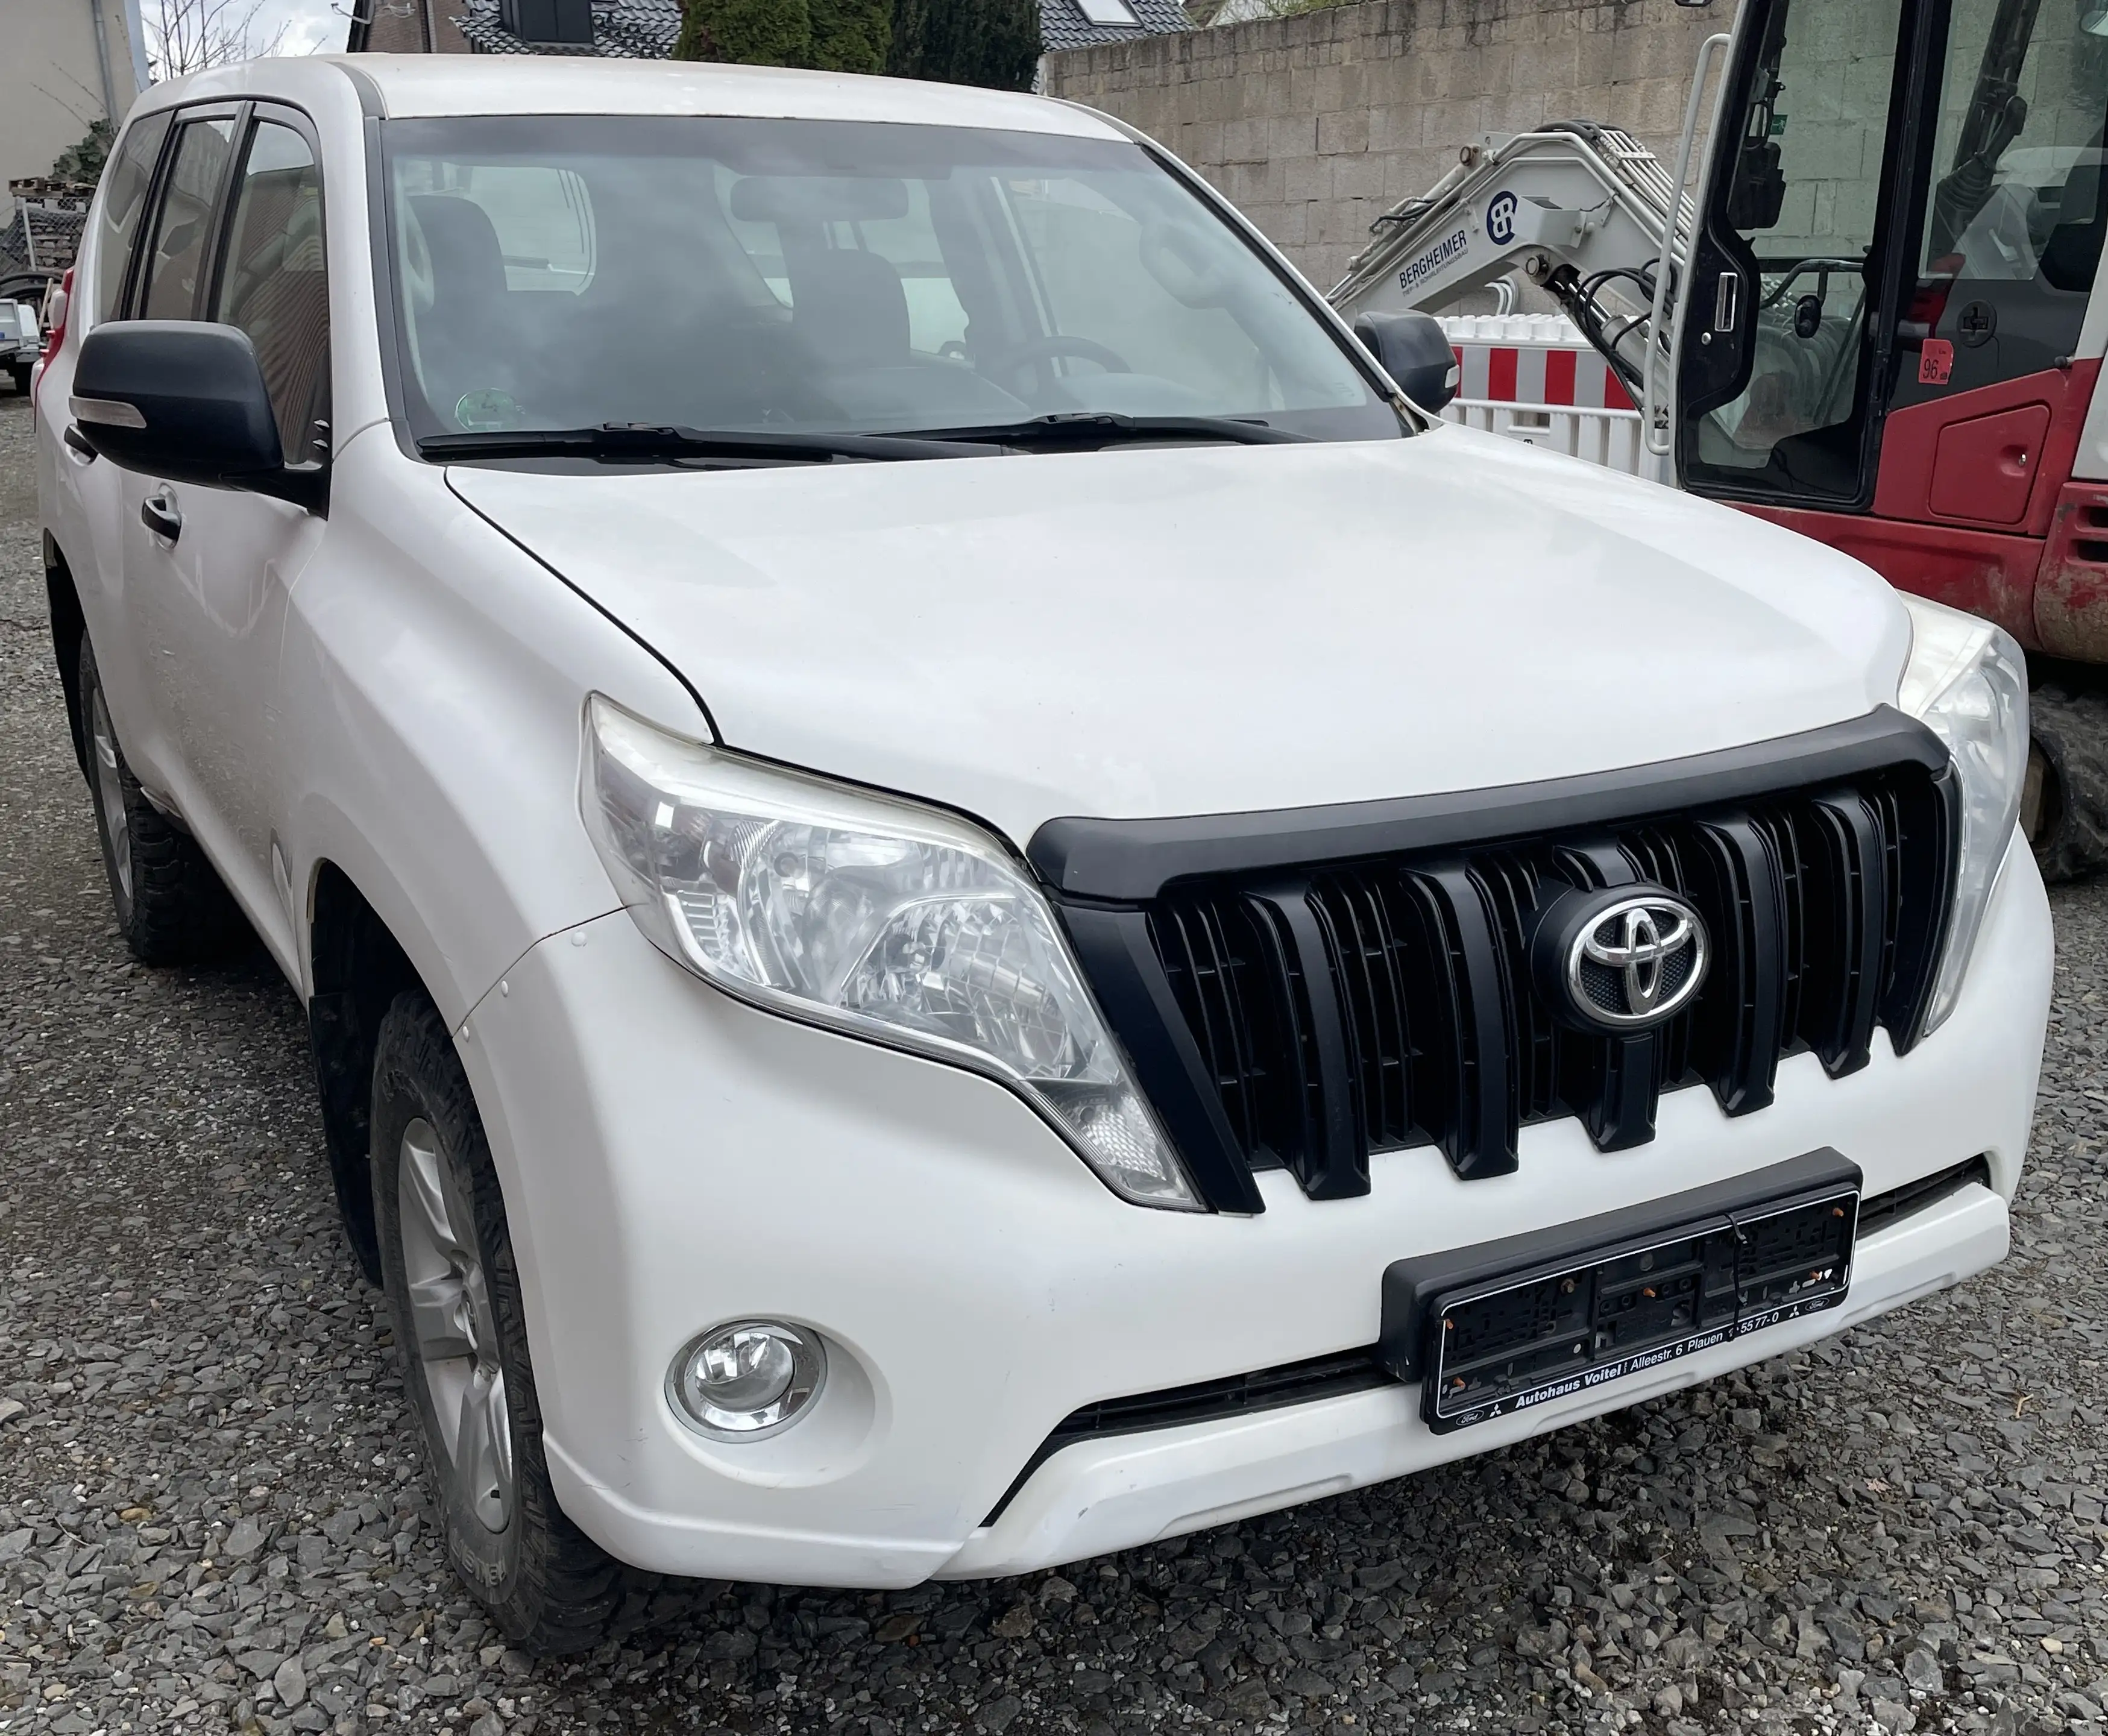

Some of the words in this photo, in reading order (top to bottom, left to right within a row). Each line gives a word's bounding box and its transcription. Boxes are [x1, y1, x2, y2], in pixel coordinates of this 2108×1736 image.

[1399, 229, 1467, 289] BERGHEIMER
[1922, 358, 1939, 379] 96
[1515, 1379, 1581, 1409] Autohaus
[1585, 1363, 1621, 1386] Voitel
[1630, 1348, 1672, 1372] Alleestr.
[1675, 1344, 1682, 1356] 6
[1687, 1332, 1723, 1352] Plauen
